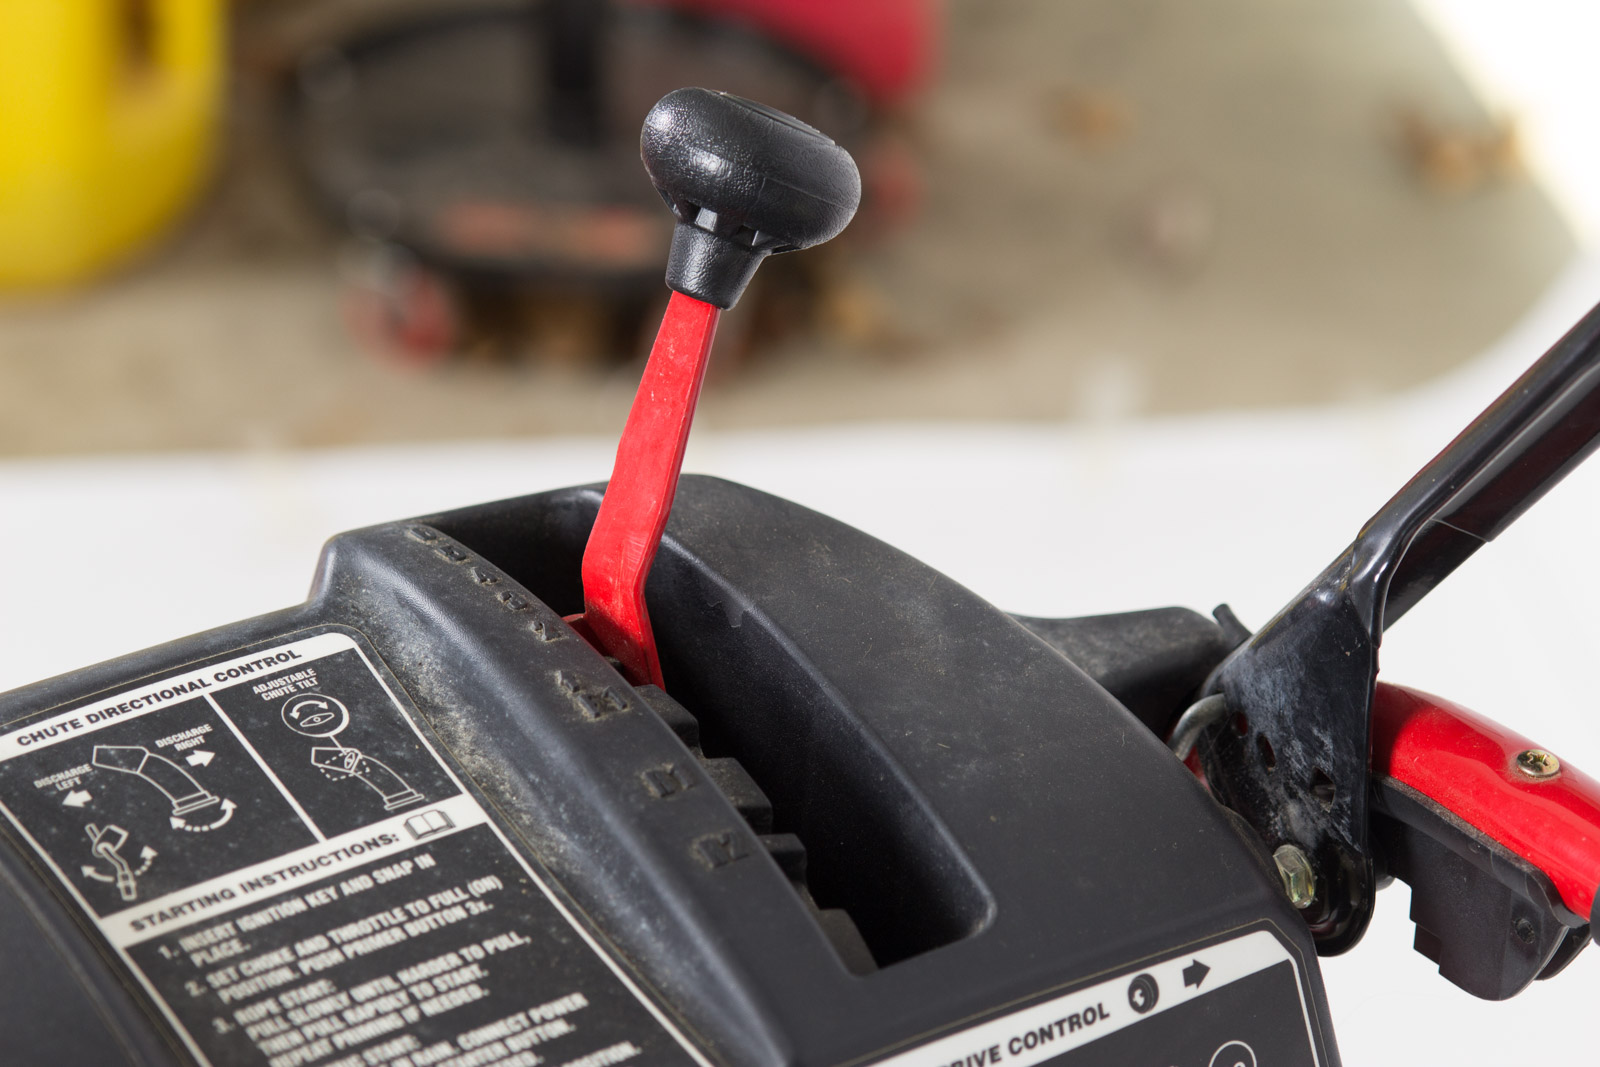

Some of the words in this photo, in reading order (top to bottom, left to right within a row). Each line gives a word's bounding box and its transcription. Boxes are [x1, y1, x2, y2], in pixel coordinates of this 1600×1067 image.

[17, 719, 83, 746] CHUTE
[85, 678, 212, 724] DIRECTIONAL
[214, 649, 302, 682] CONTROL
[252, 668, 317, 694] ADJUSTABLE
[261, 684, 297, 701] CHUTE
[296, 677, 318, 689] TILT
[155, 724, 213, 748] DISCHARGE
[174, 735, 206, 751] RIGHT
[33, 763, 93, 789] DISCHARGE
[55, 776, 82, 791] LEFT
[129, 889, 237, 932] STARTING
[240, 833, 401, 894] INSTRUCTIONS:
[179, 922, 237, 951] INSERT
[236, 897, 307, 932] IGNITION
[304, 886, 338, 908] KEY
[340, 874, 374, 896] AND
[372, 860, 413, 884] SNAP
[414, 853, 436, 870] IN
[190, 938, 251, 967] PLACE.
[205, 966, 240, 989] SET
[238, 946, 297, 977] CHOKE
[294, 934, 330, 958] AND
[327, 907, 408, 944] THROTTLE
[405, 899, 430, 915] TO
[428, 886, 470, 910] FULL
[467, 874, 503, 898] (ON)
[217, 966, 300, 1004] POSITION.
[297, 949, 345, 975] PUSH
[342, 927, 407, 960] PRIMER
[403, 903, 468, 937] BUTTON
[233, 998, 282, 1026] ROPE
[278, 979, 337, 1009] START:
[246, 1016, 291, 1041] PULL
[458, 944, 486, 962] TO
[482, 931, 532, 955] PULL,
[301, 1015, 346, 1041] PULL
[409, 981, 436, 1000] TO
[432, 963, 489, 994] START.
[457, 1012, 530, 1050] CONNECT
[528, 992, 589, 1024] POWER
[1008, 1003, 1110, 1056] CONTROL
